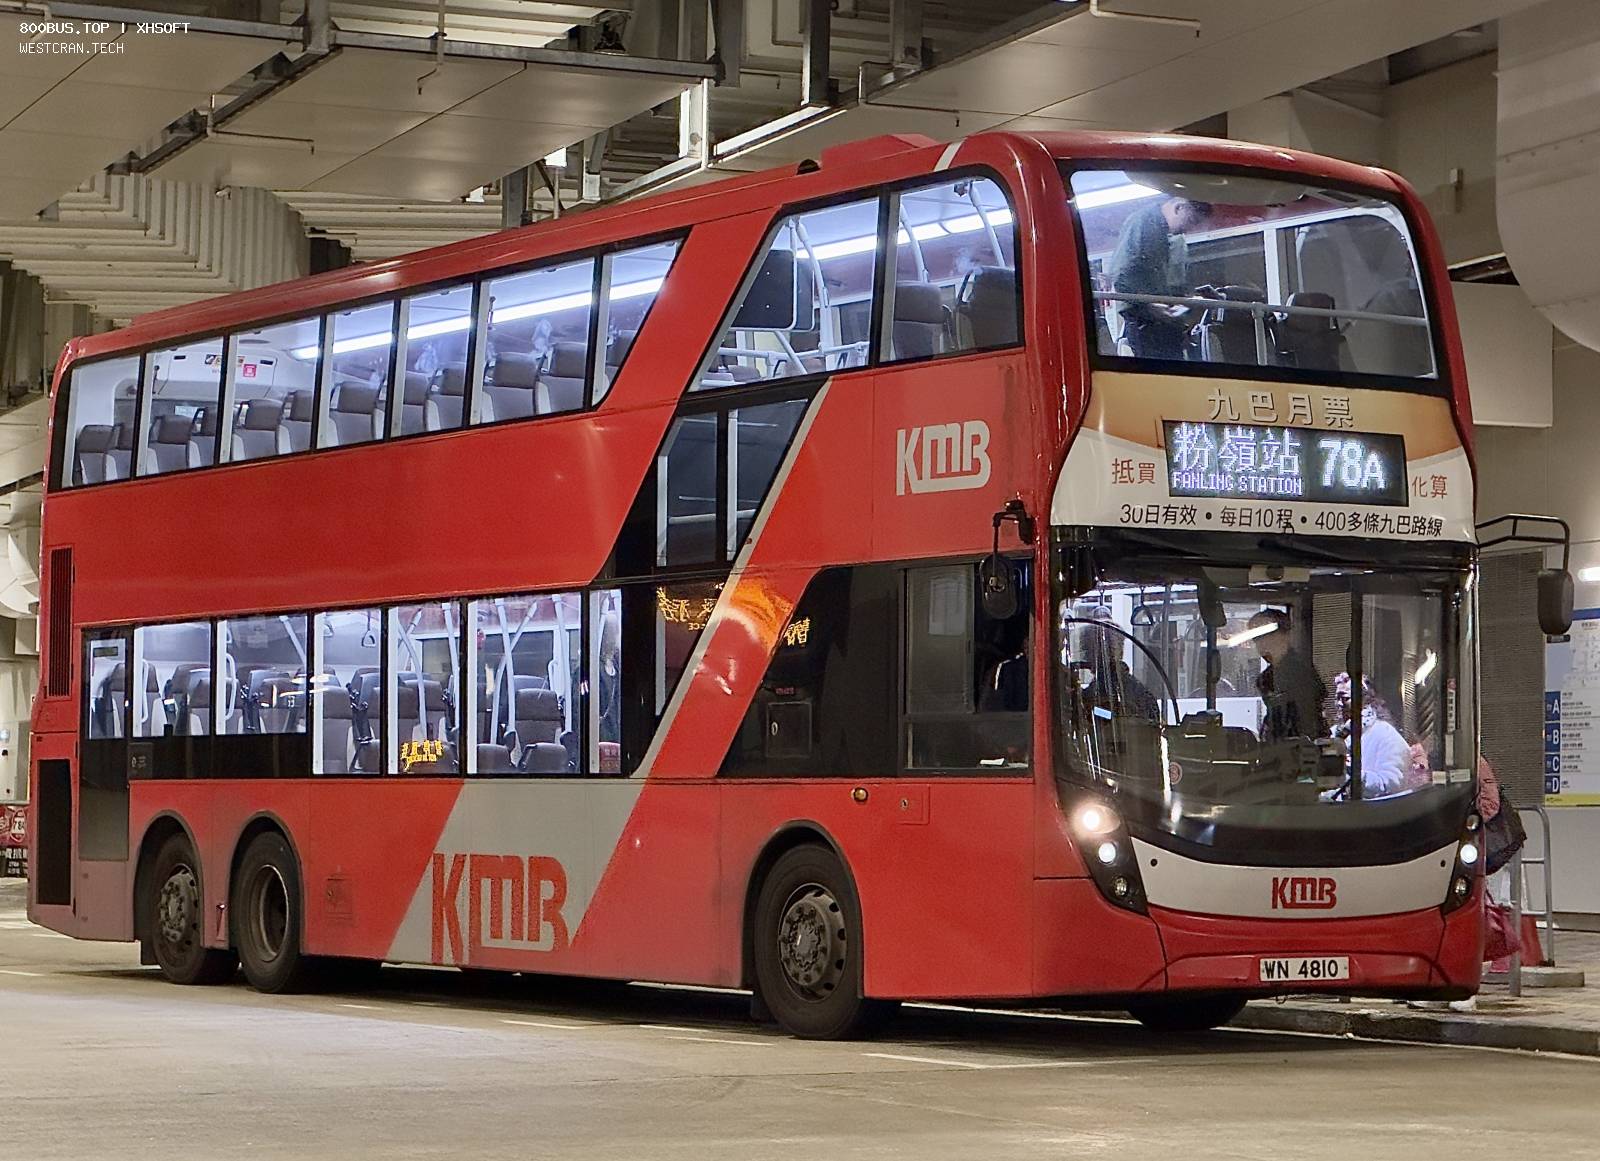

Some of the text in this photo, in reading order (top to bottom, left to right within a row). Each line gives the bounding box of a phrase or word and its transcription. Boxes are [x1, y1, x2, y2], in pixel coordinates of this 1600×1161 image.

[1207, 388, 1354, 428] 九巴月票
[896, 420, 992, 496] KMB
[1173, 421, 1301, 474] 粉嶺站
[1112, 458, 1156, 485] 抵買
[1319, 438, 1387, 489] 78A
[1172, 471, 1303, 496] FANLING STATION
[1412, 474, 1448, 500] 化算
[1552, 699, 1560, 714] A
[1552, 729, 1560, 745] B
[1552, 756, 1560, 772] C
[1552, 777, 1560, 793] D
[1271, 877, 1337, 909] KMB
[1264, 959, 1339, 979] WN 4810
